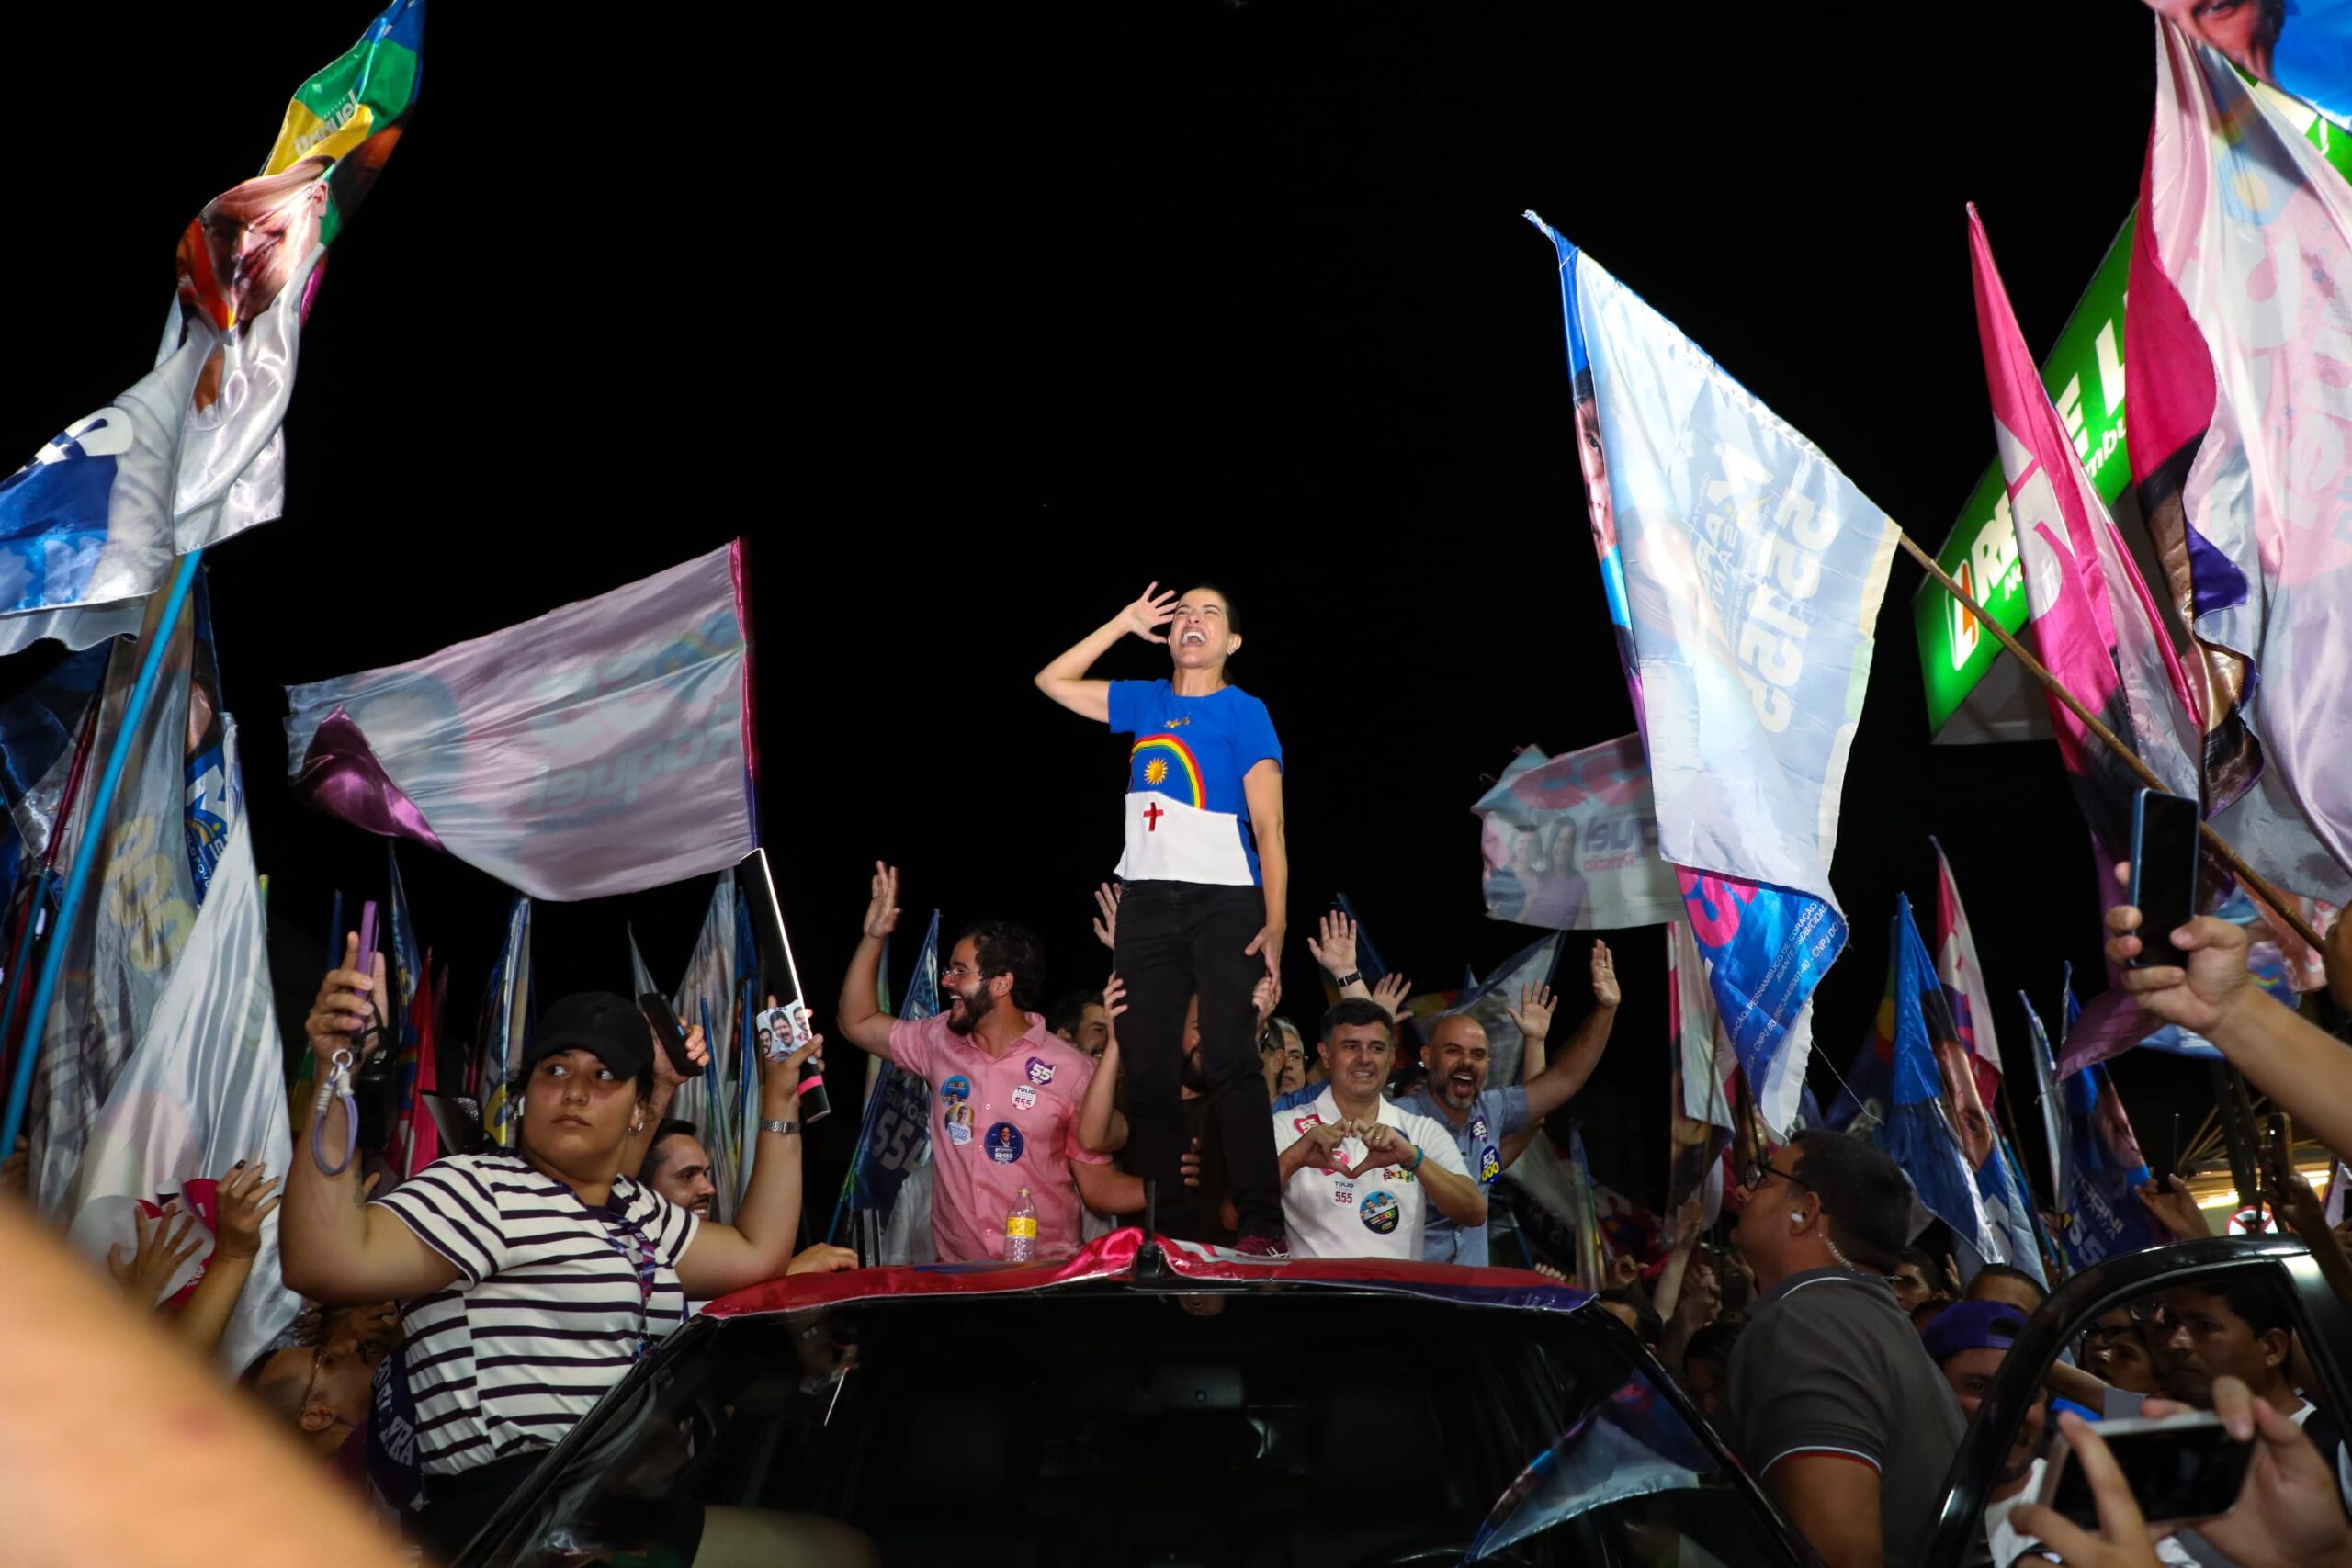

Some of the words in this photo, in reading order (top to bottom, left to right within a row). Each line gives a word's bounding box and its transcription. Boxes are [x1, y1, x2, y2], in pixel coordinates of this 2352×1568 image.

[1789, 902, 1818, 942] CORAÇÃO
[1483, 1150, 1496, 1170] 55
[1335, 1191, 1352, 1204] 555
